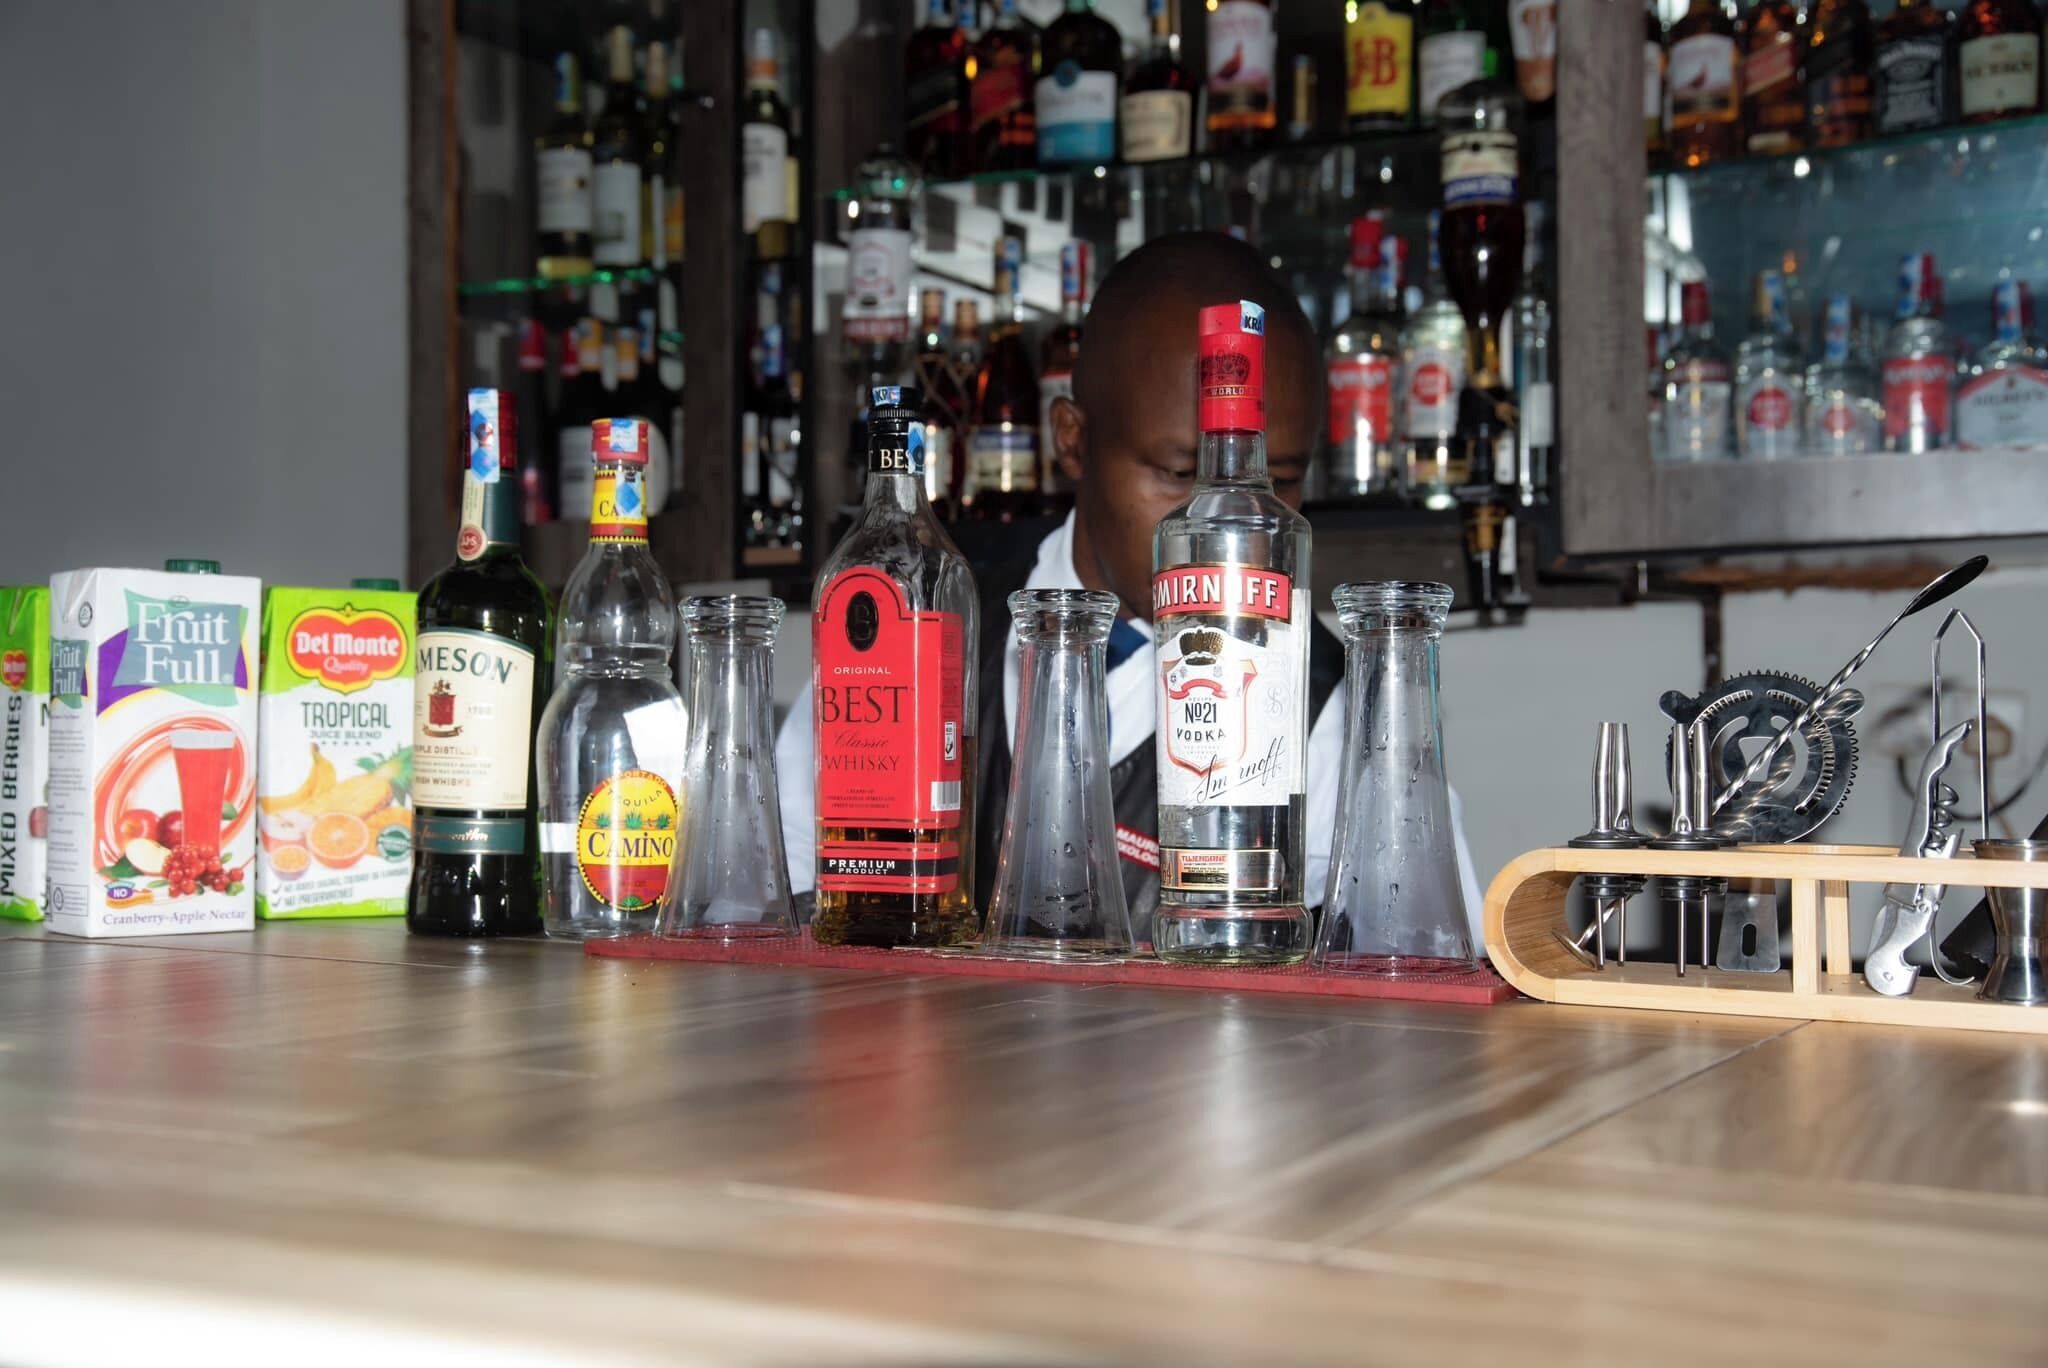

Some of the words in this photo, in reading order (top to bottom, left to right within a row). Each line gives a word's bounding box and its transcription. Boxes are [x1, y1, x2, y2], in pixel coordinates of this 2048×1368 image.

[1153, 574, 1278, 610] SMIRNFF
[133, 601, 230, 645] Fruit
[296, 631, 330, 655] Del
[332, 632, 400, 657] Monte
[139, 643, 221, 684] Full
[415, 646, 512, 684] MESON
[833, 666, 891, 675] ORIGINAL
[301, 701, 391, 728] TROPICAL
[821, 686, 908, 723] BEST
[1177, 727, 1226, 741] VODKA
[2, 695, 22, 800] BERRIES
[823, 754, 900, 771] WHISKY
[607, 786, 663, 807] TQUILA
[0, 811, 17, 896] MIXED
[829, 859, 896, 869] PREMIUM
[838, 867, 888, 875] PRODUCT
[113, 888, 128, 898] NO
[102, 910, 206, 926] Cranberry-Apple
[208, 910, 247, 919] Nectar
